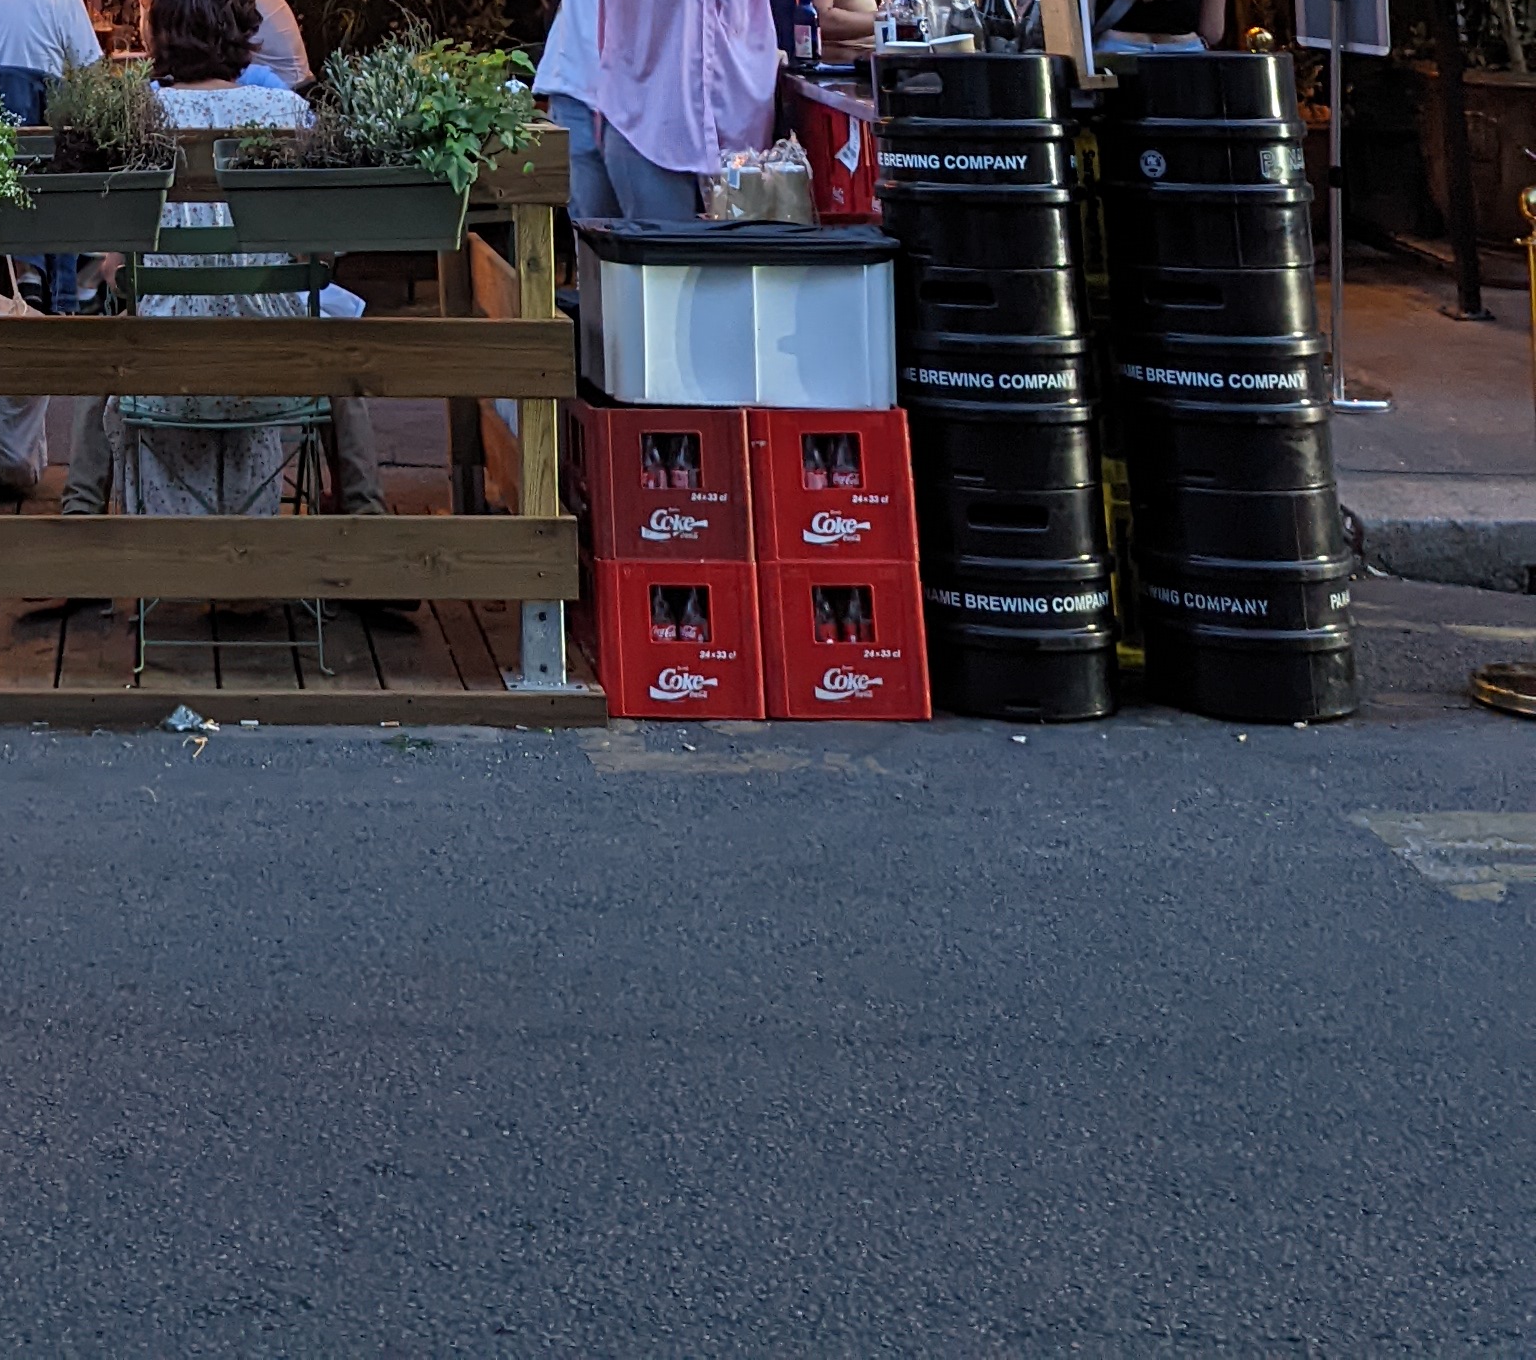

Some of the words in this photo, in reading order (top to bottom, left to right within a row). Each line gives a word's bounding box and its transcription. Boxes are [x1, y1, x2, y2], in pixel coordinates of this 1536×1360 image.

[883, 152, 941, 170] BREWING
[944, 154, 1028, 170] COMPANY
[919, 368, 994, 389] BREWING
[998, 369, 1077, 389] COMPANY
[1145, 367, 1224, 388] BREWING
[1228, 369, 1307, 389] COMPANY
[650, 509, 708, 531] Coke
[812, 512, 871, 534] Coke
[924, 586, 962, 607] NAME
[965, 592, 1049, 613] BREWING
[1052, 590, 1110, 613] COMPANY
[1184, 591, 1269, 616] COMPANY
[659, 668, 718, 691] Coke
[823, 668, 883, 691] Coke
